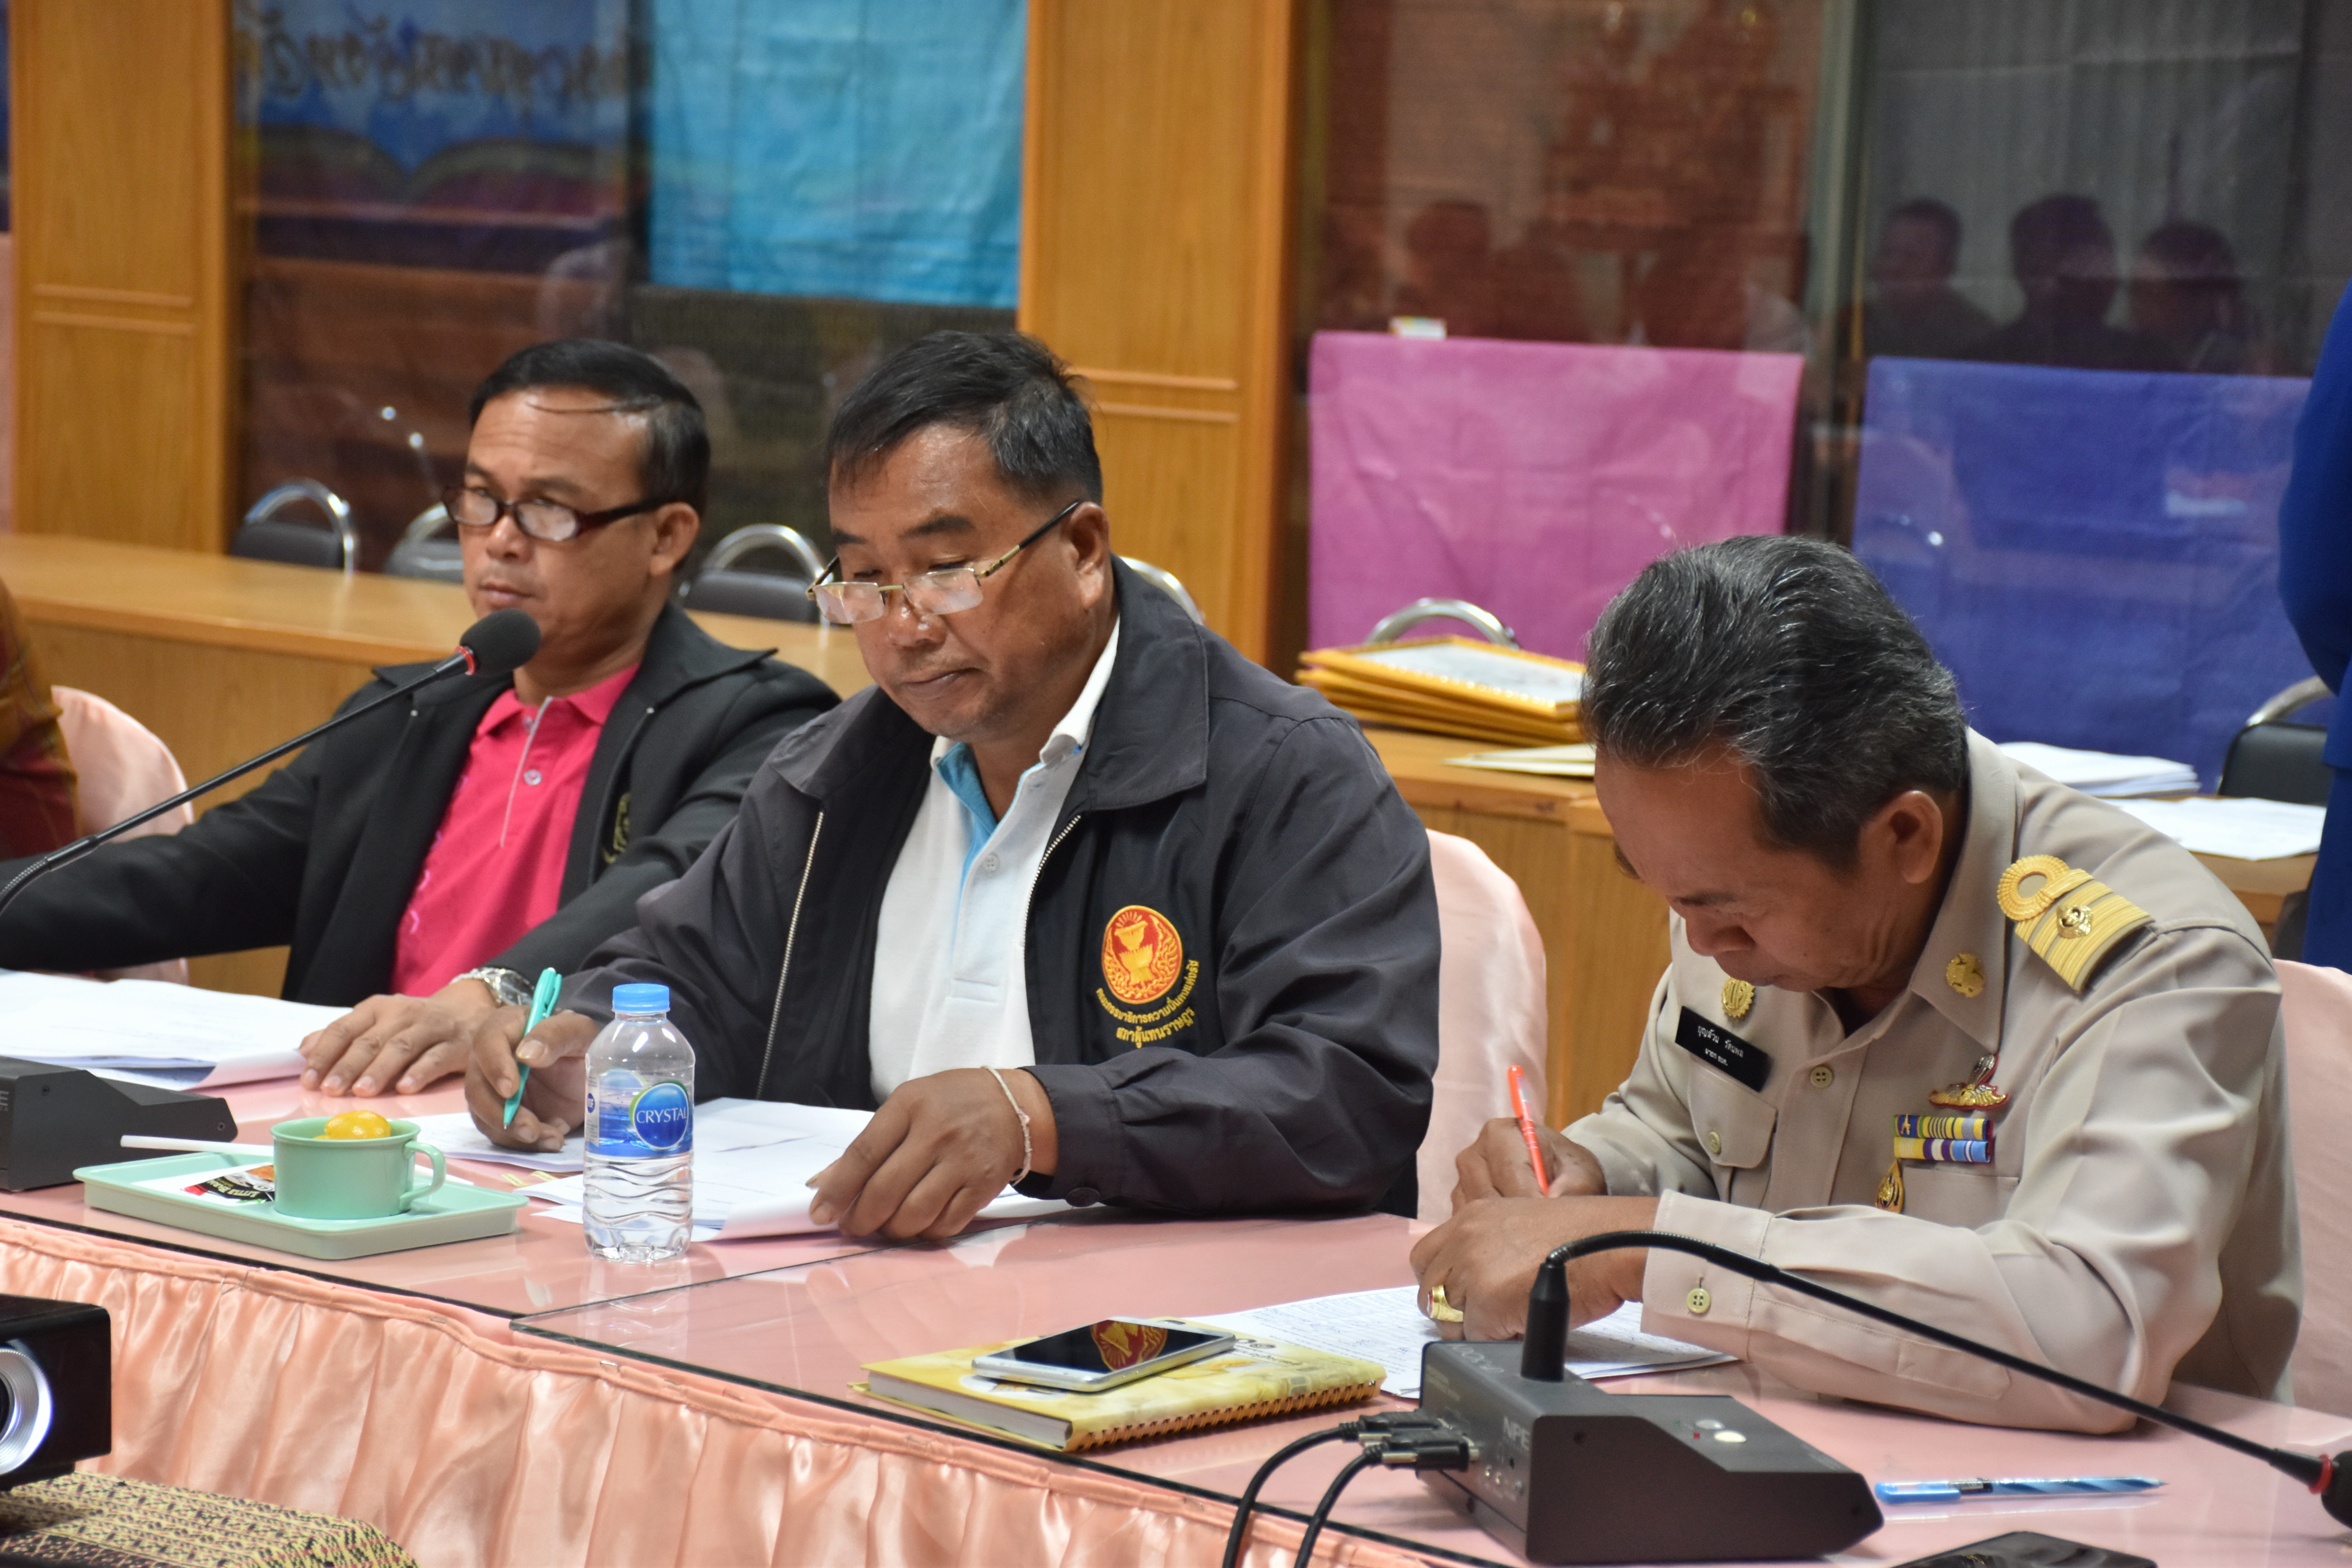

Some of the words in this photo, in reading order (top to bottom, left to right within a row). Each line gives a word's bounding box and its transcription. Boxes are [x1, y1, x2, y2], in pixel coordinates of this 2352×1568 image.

[1116, 1006, 1196, 1048] สภาผู้แทนราษฎร
[636, 1107, 687, 1123] CRYSTAL
